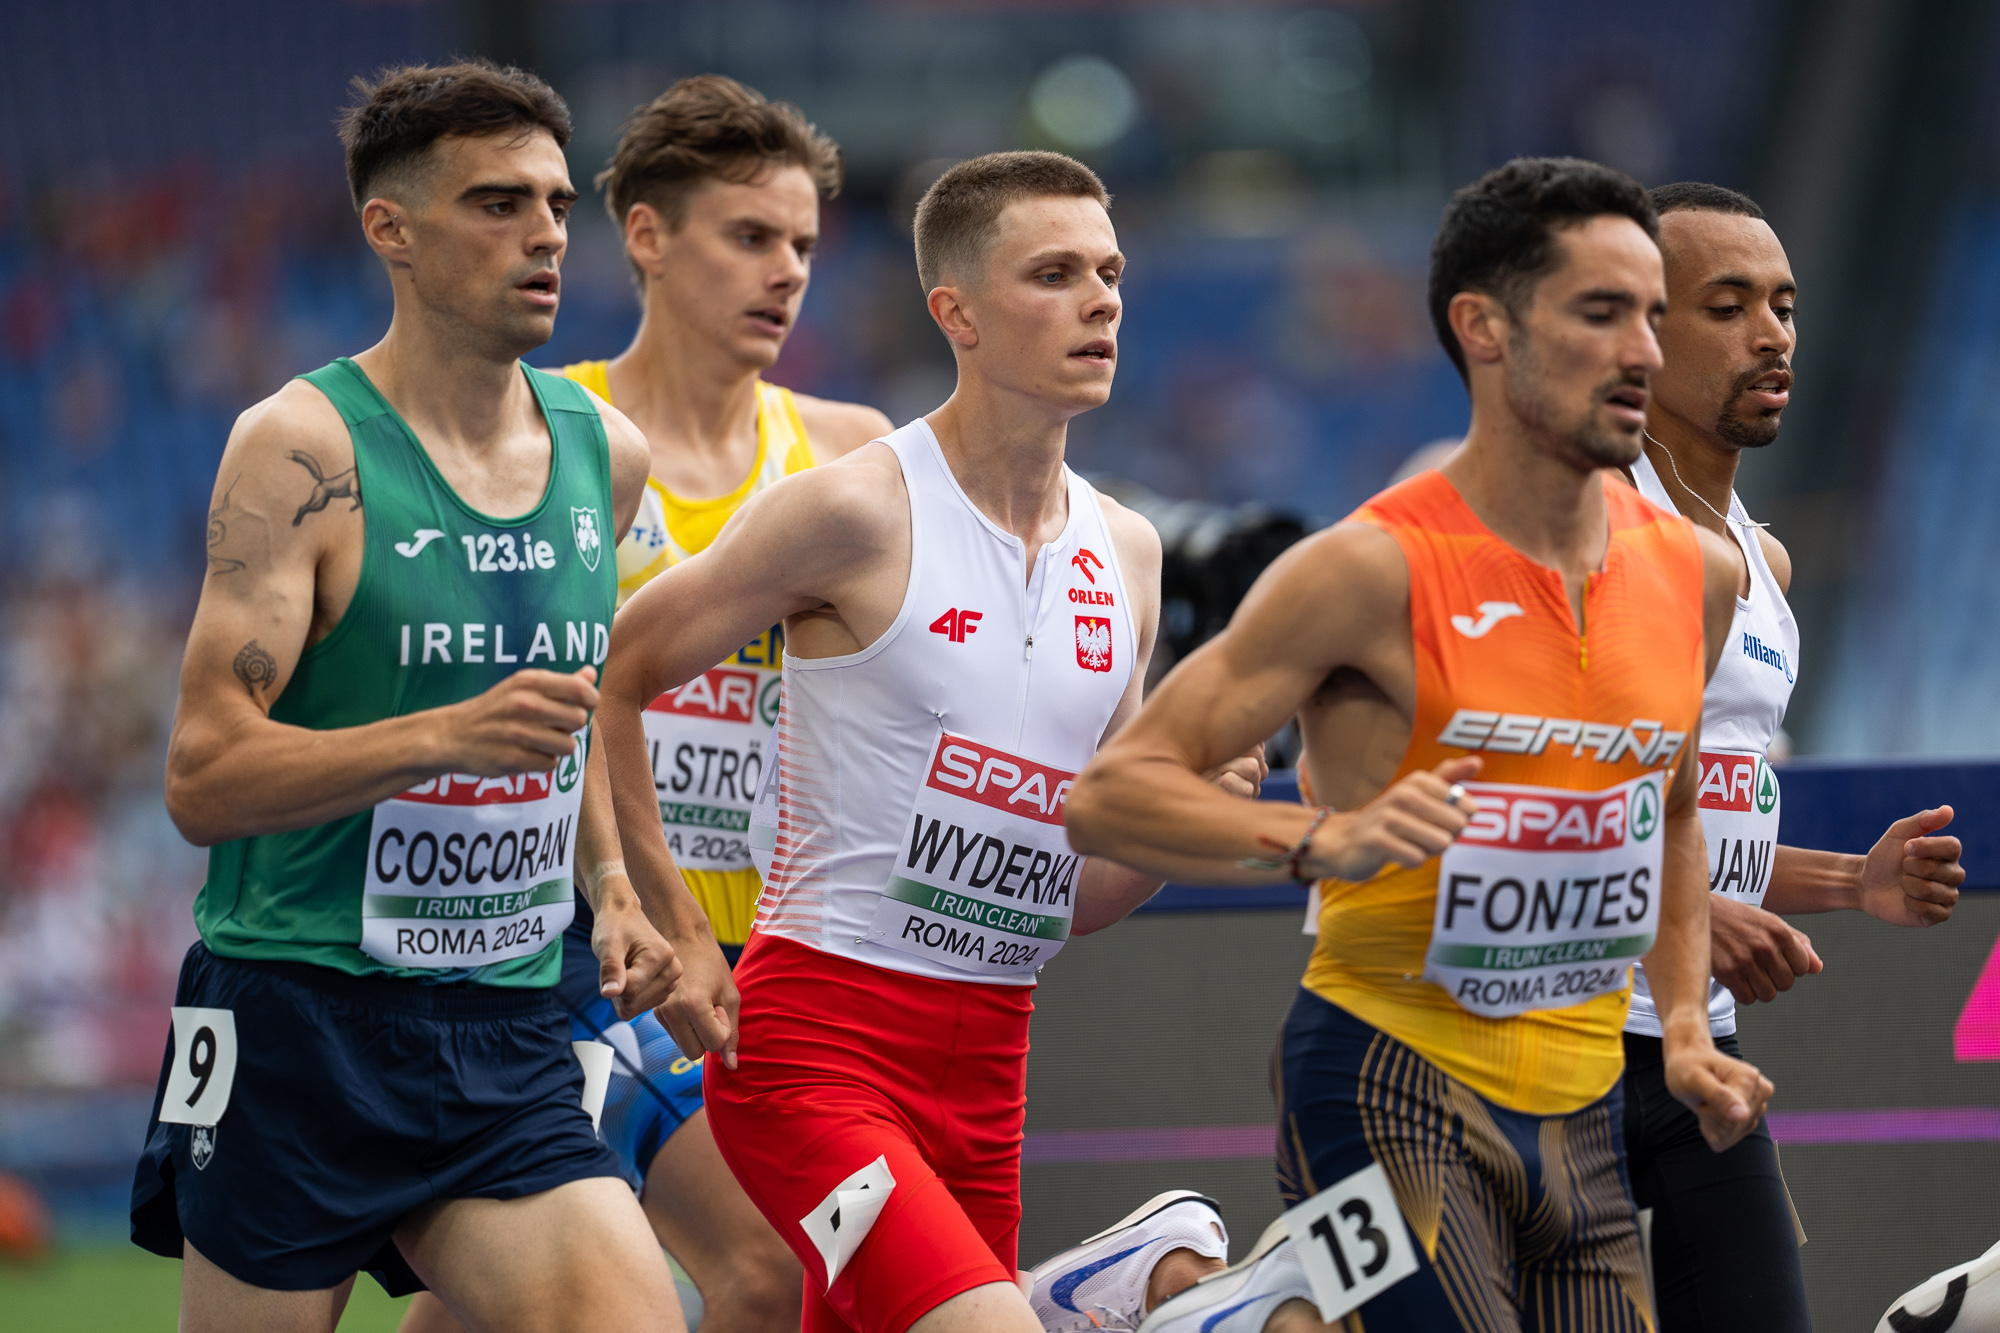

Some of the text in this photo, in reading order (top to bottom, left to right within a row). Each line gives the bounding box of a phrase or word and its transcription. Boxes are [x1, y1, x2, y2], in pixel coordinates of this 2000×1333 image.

[461, 532, 556, 572] 123.ie
[1068, 588, 1115, 607] ORLEN
[400, 621, 610, 666] IRELAND
[929, 607, 983, 643] 4F
[1743, 632, 1783, 671] Allianz
[664, 674, 753, 717] AR
[1437, 708, 1687, 767] ESPAÑA
[645, 738, 762, 802] LSTRÖ
[1697, 760, 1751, 803] AR
[679, 804, 746, 829] CLEAN
[1460, 796, 1625, 844] SPAR
[374, 814, 572, 886] COSCORAN
[906, 813, 1079, 906] WYDERKA
[1704, 838, 1771, 893] JANI
[415, 898, 424, 916] I
[426, 898, 475, 917] RUN
[931, 892, 940, 908] I
[941, 893, 986, 921] RUN
[1443, 866, 1651, 933] FONTES
[397, 916, 546, 954] ROMA 2024
[901, 915, 1040, 966] ROMA 2024
[1483, 948, 1493, 968] I
[1495, 947, 1541, 968] RUN
[1457, 967, 1617, 1005] ROMA 2024
[184, 1026, 217, 1108] 9
[1310, 1197, 1389, 1291] 13
